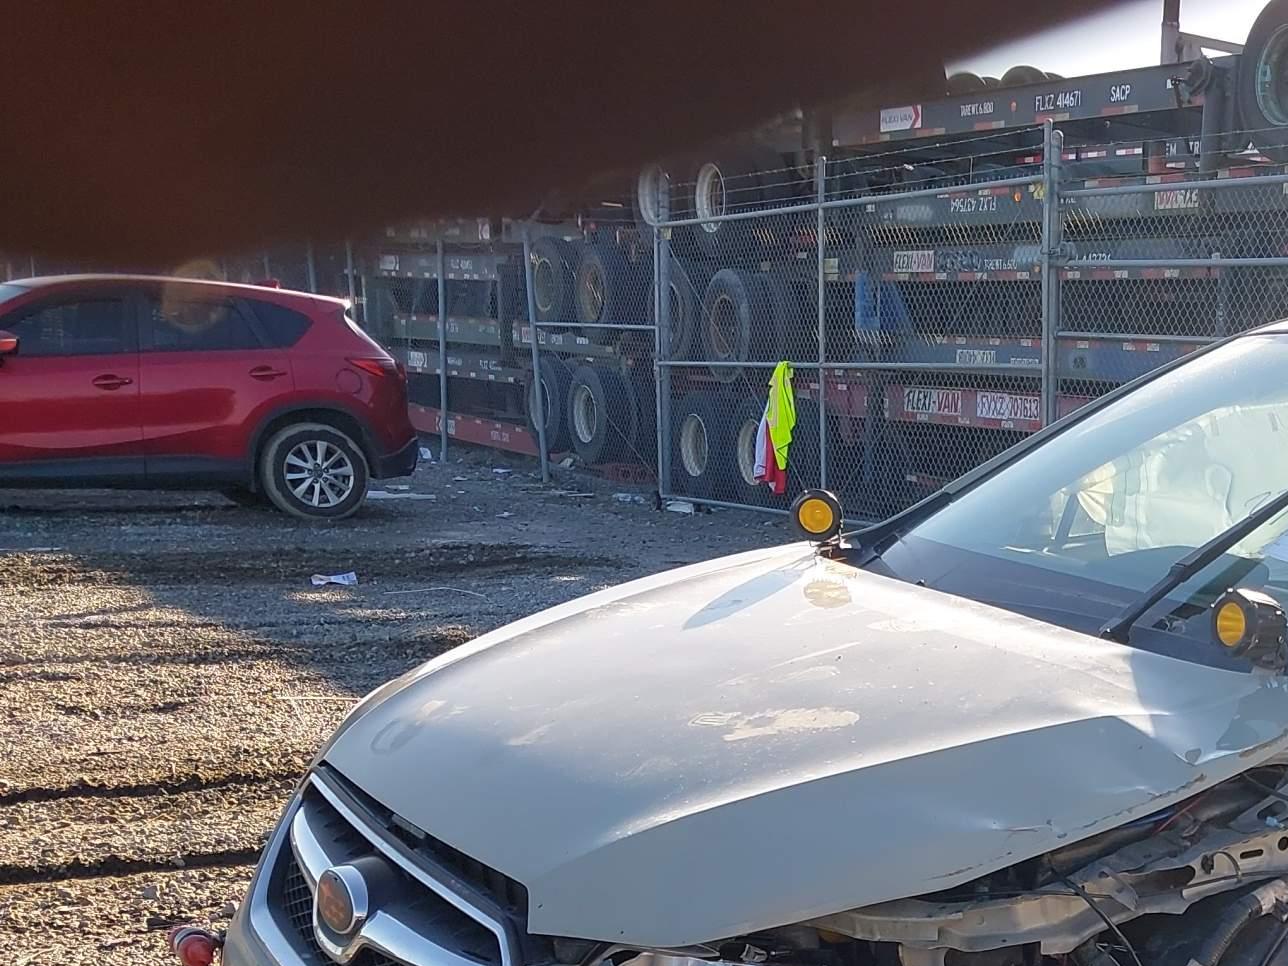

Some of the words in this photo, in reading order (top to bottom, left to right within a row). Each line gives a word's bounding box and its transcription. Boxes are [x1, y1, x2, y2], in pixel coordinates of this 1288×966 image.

[1035, 94, 1054, 112] FLXZ
[1056, 90, 1081, 109] 414671
[1110, 84, 1130, 102] SACP
